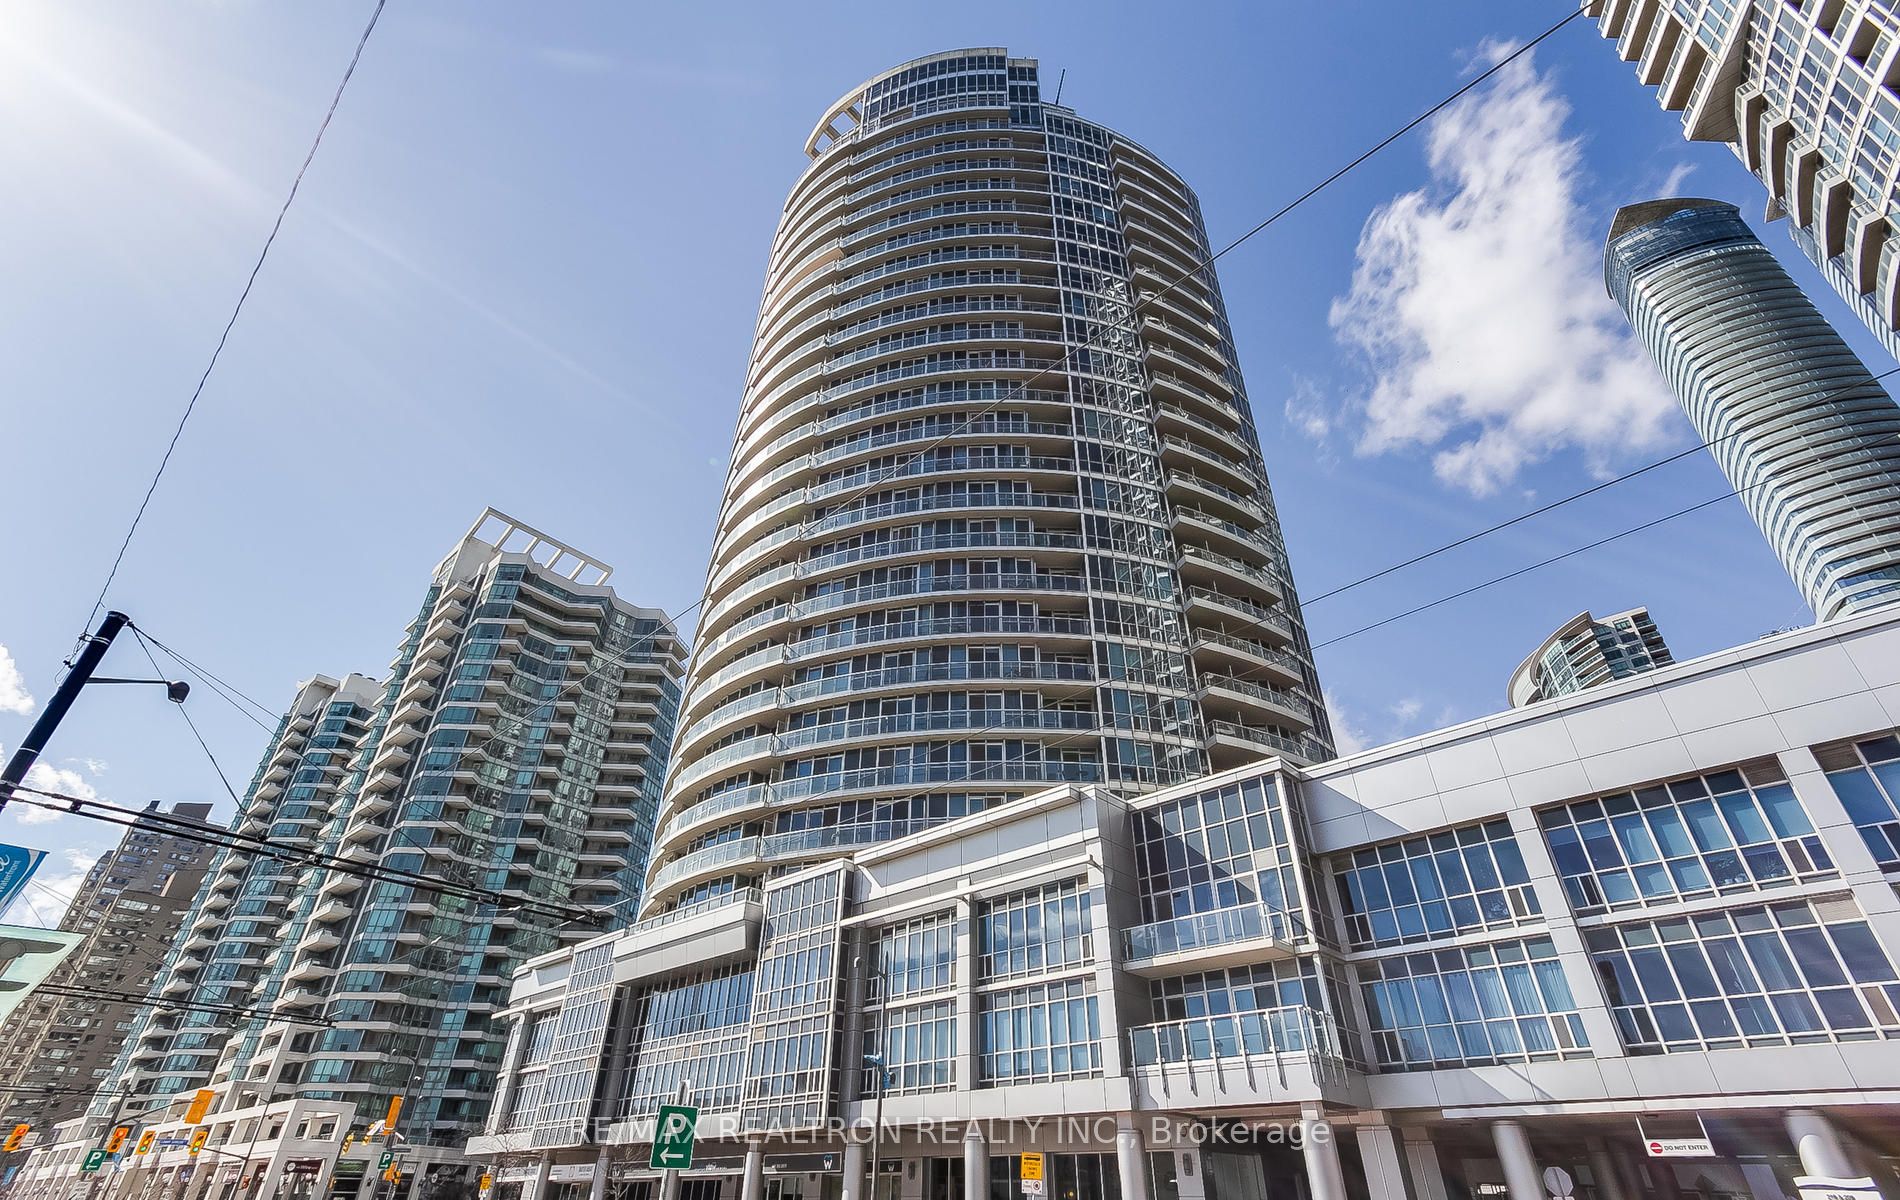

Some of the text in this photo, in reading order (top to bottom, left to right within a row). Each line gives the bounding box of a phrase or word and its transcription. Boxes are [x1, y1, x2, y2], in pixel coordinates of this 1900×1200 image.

[663, 1113, 687, 1144] P
[89, 1151, 102, 1164] P
[382, 1153, 391, 1164] P
